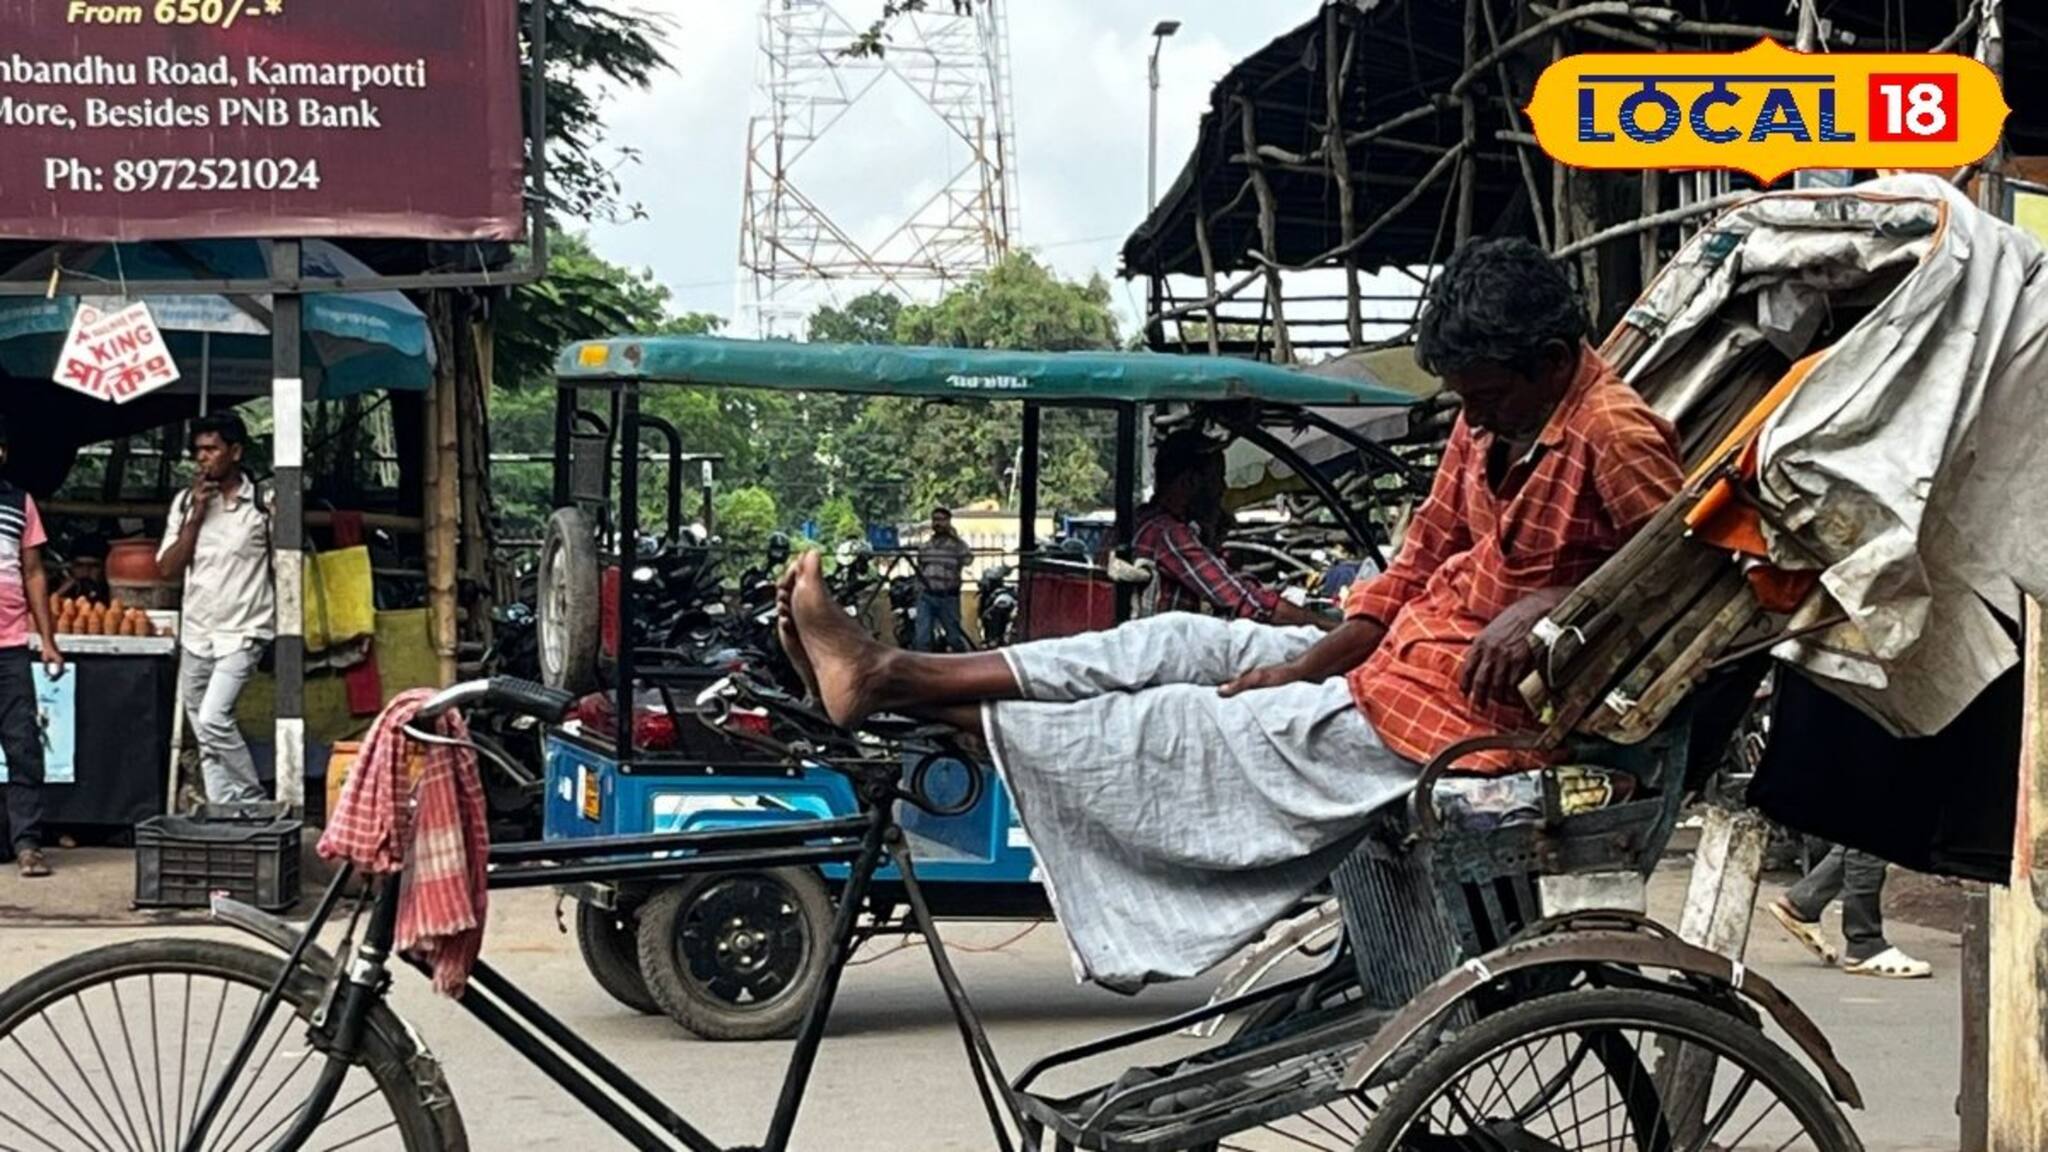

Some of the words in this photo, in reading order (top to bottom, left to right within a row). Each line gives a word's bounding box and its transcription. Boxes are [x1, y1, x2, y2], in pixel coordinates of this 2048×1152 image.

[67, 1, 142, 24] From
[148, 56, 238, 87] Road,
[247, 56, 426, 92] Kamarpotti
[86, 98, 210, 127] Besides
[219, 98, 289, 126] PNB
[299, 99, 381, 128] Bank
[45, 158, 103, 190] Ph:
[113, 158, 320, 191] 8972521024
